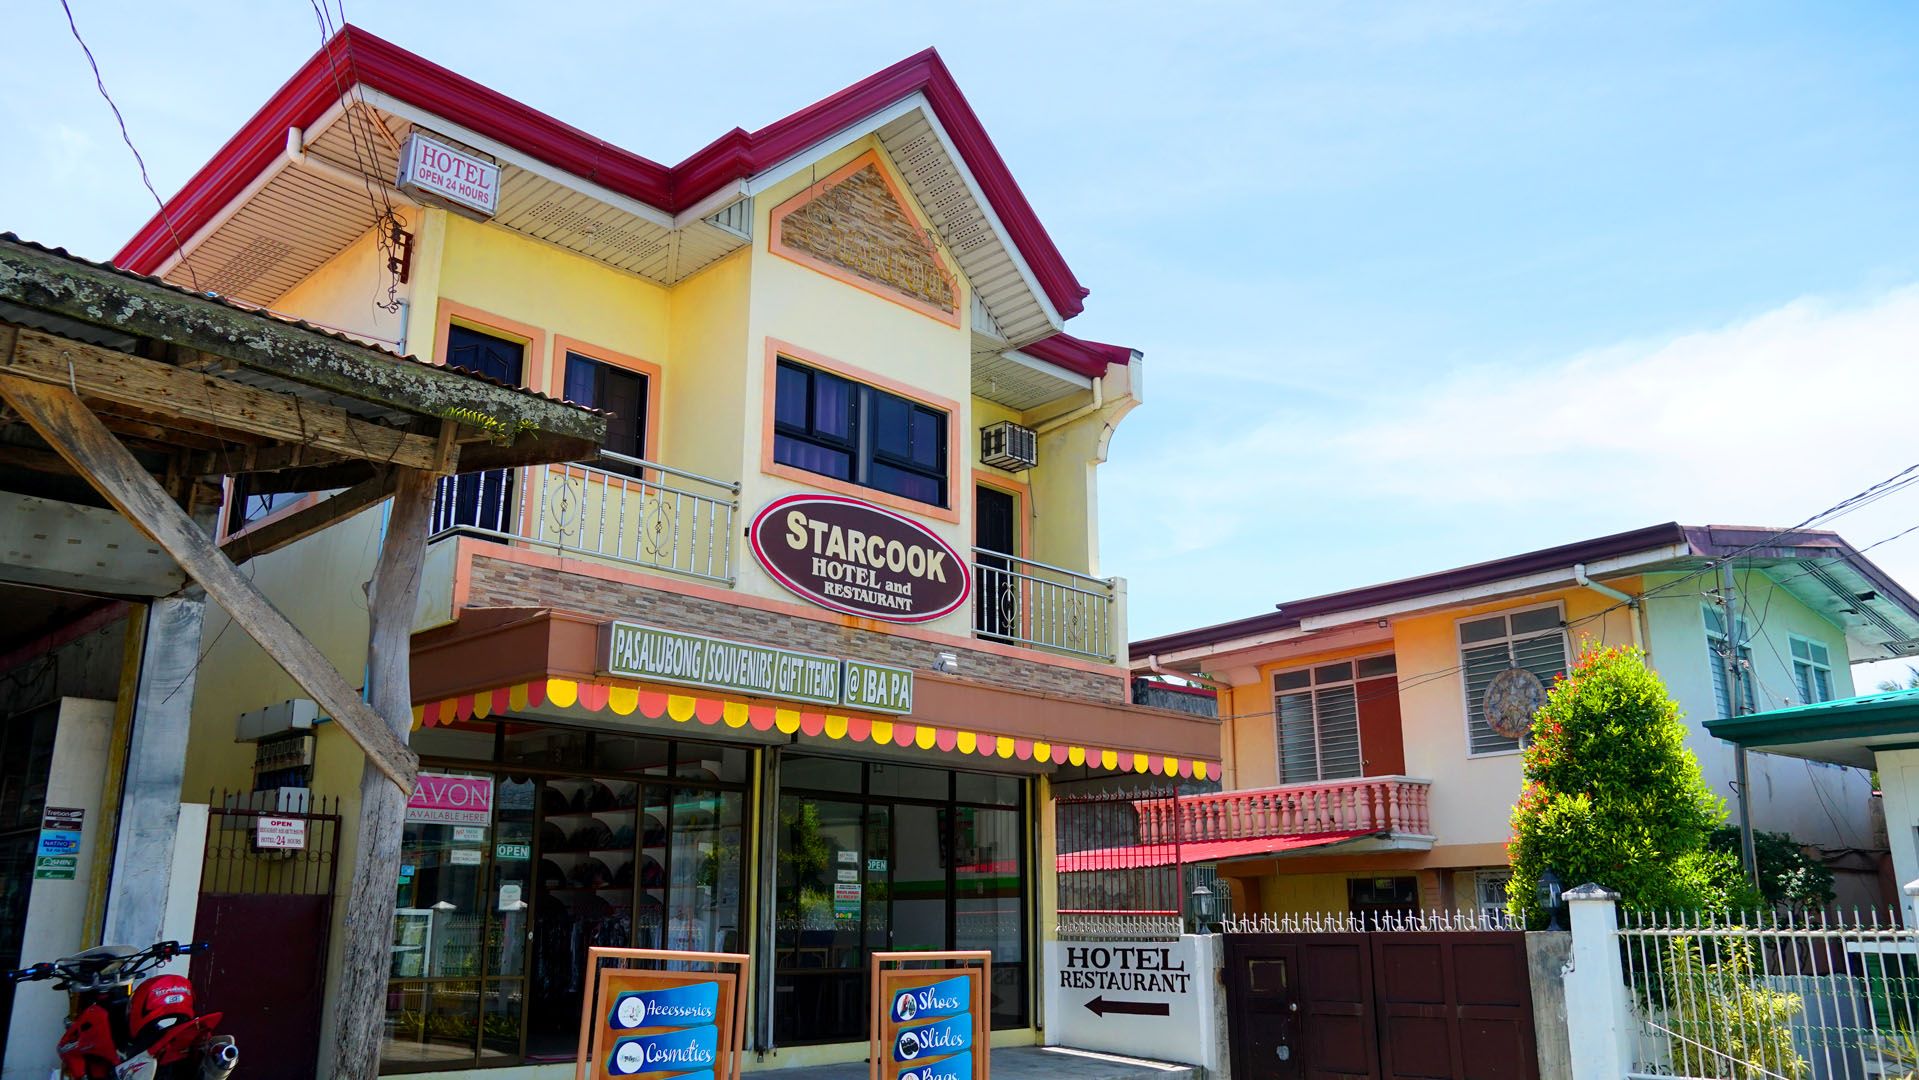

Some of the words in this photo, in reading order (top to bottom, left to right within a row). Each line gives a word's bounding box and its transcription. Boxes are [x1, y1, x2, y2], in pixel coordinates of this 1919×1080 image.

[421, 144, 490, 190] HOTEL
[419, 168, 444, 187] OPEN
[446, 178, 456, 191] 24
[459, 184, 489, 204] HOURS
[785, 510, 947, 584] STARCOOK
[812, 557, 881, 589] HOTEL
[885, 581, 912, 596] and
[824, 581, 913, 611] RESTAURANT
[615, 629, 702, 679] PASALUBONG
[707, 644, 773, 689] SOUVENIRS
[779, 655, 804, 693] GIFT
[804, 659, 836, 698] ITEMS
[847, 666, 860, 702] @
[862, 668, 888, 705] IBA
[890, 673, 910, 709] PA
[408, 782, 488, 807] AVON
[410, 810, 459, 821] AVAILABLE
[462, 813, 485, 822] HERE
[276, 835, 286, 845] 24
[499, 845, 528, 857] OPEN
[1067, 946, 1184, 972] HOTEL
[1060, 970, 1191, 994] RESTAURANT
[646, 999, 712, 1017] Accessories
[919, 987, 960, 1010] Shoes
[920, 1026, 965, 1049] Slides
[646, 1039, 713, 1063] Cosmetics
